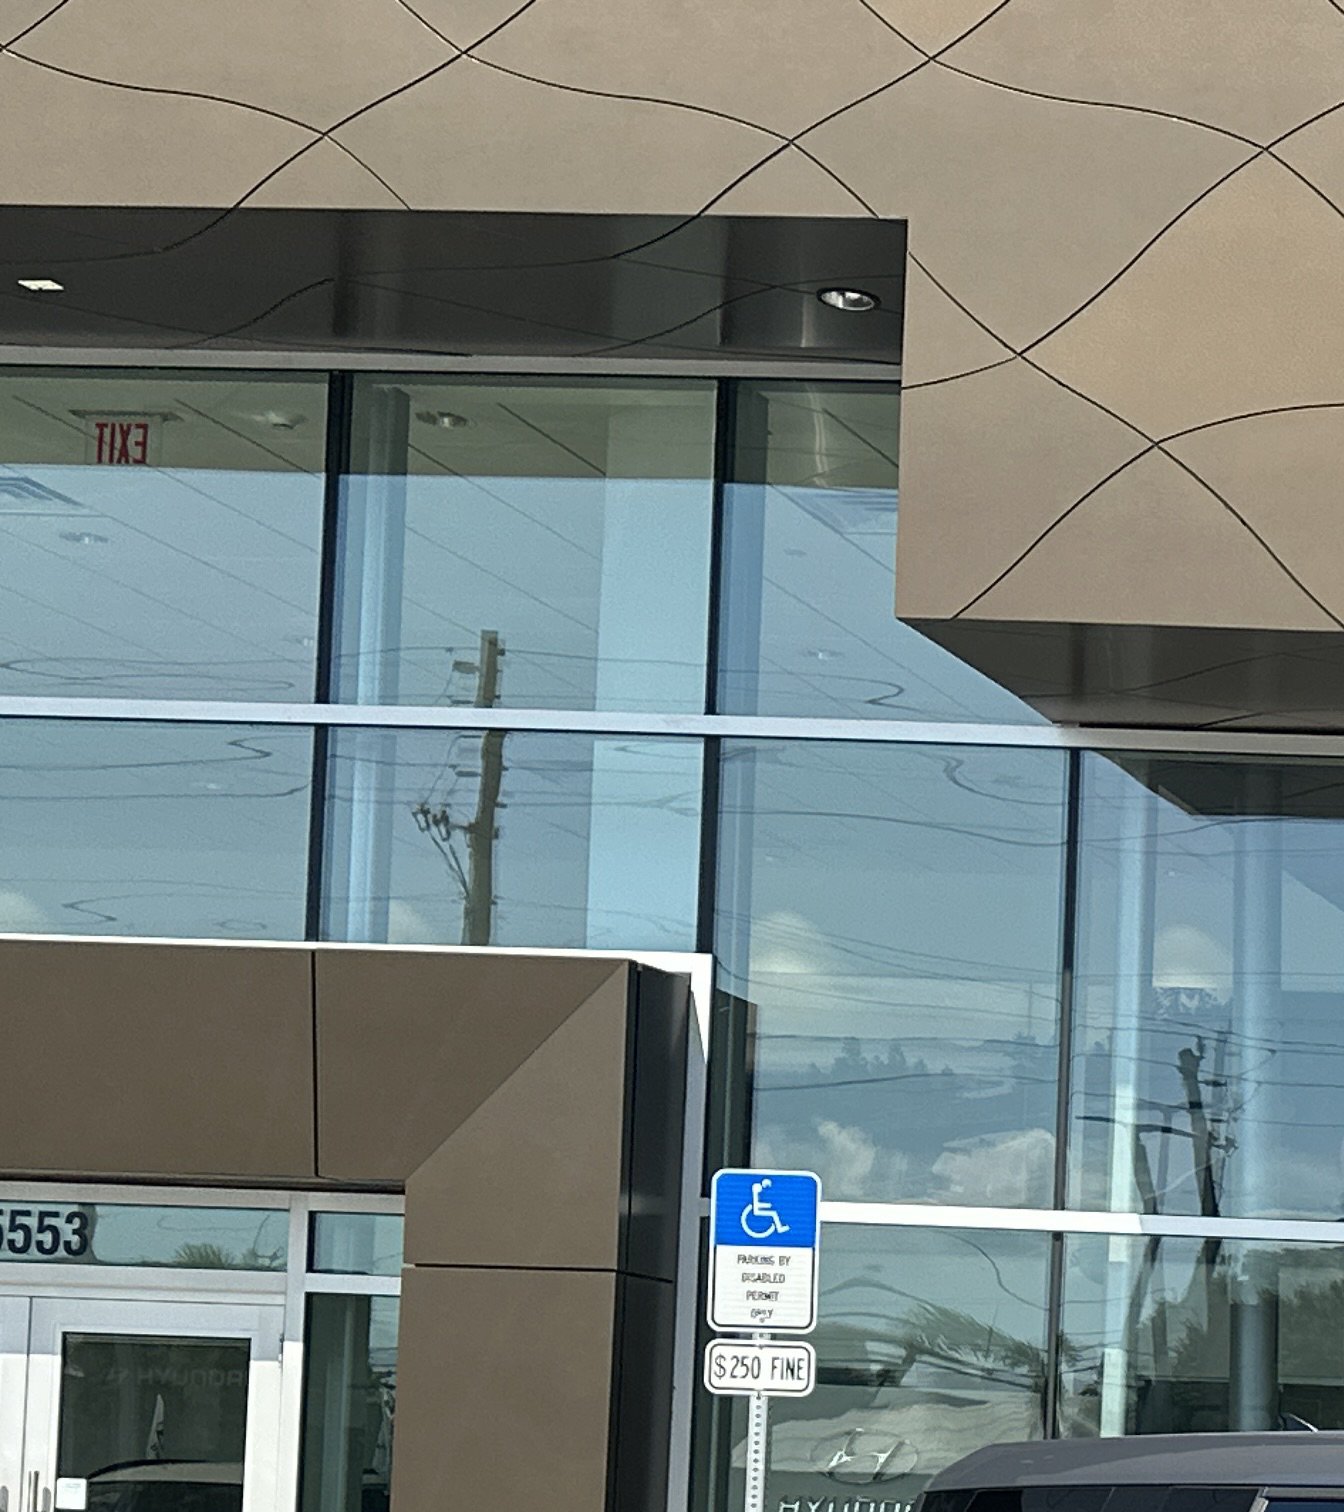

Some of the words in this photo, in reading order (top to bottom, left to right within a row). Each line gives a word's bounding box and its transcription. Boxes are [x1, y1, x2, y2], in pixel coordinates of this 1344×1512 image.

[0, 1209, 89, 1256] 553
[737, 1254, 775, 1266] PARKING
[778, 1256, 791, 1267] BY
[741, 1273, 786, 1284] DISABLED
[746, 1291, 779, 1301] PERMIT
[714, 1354, 760, 1380] $250
[770, 1356, 805, 1381] FINE
